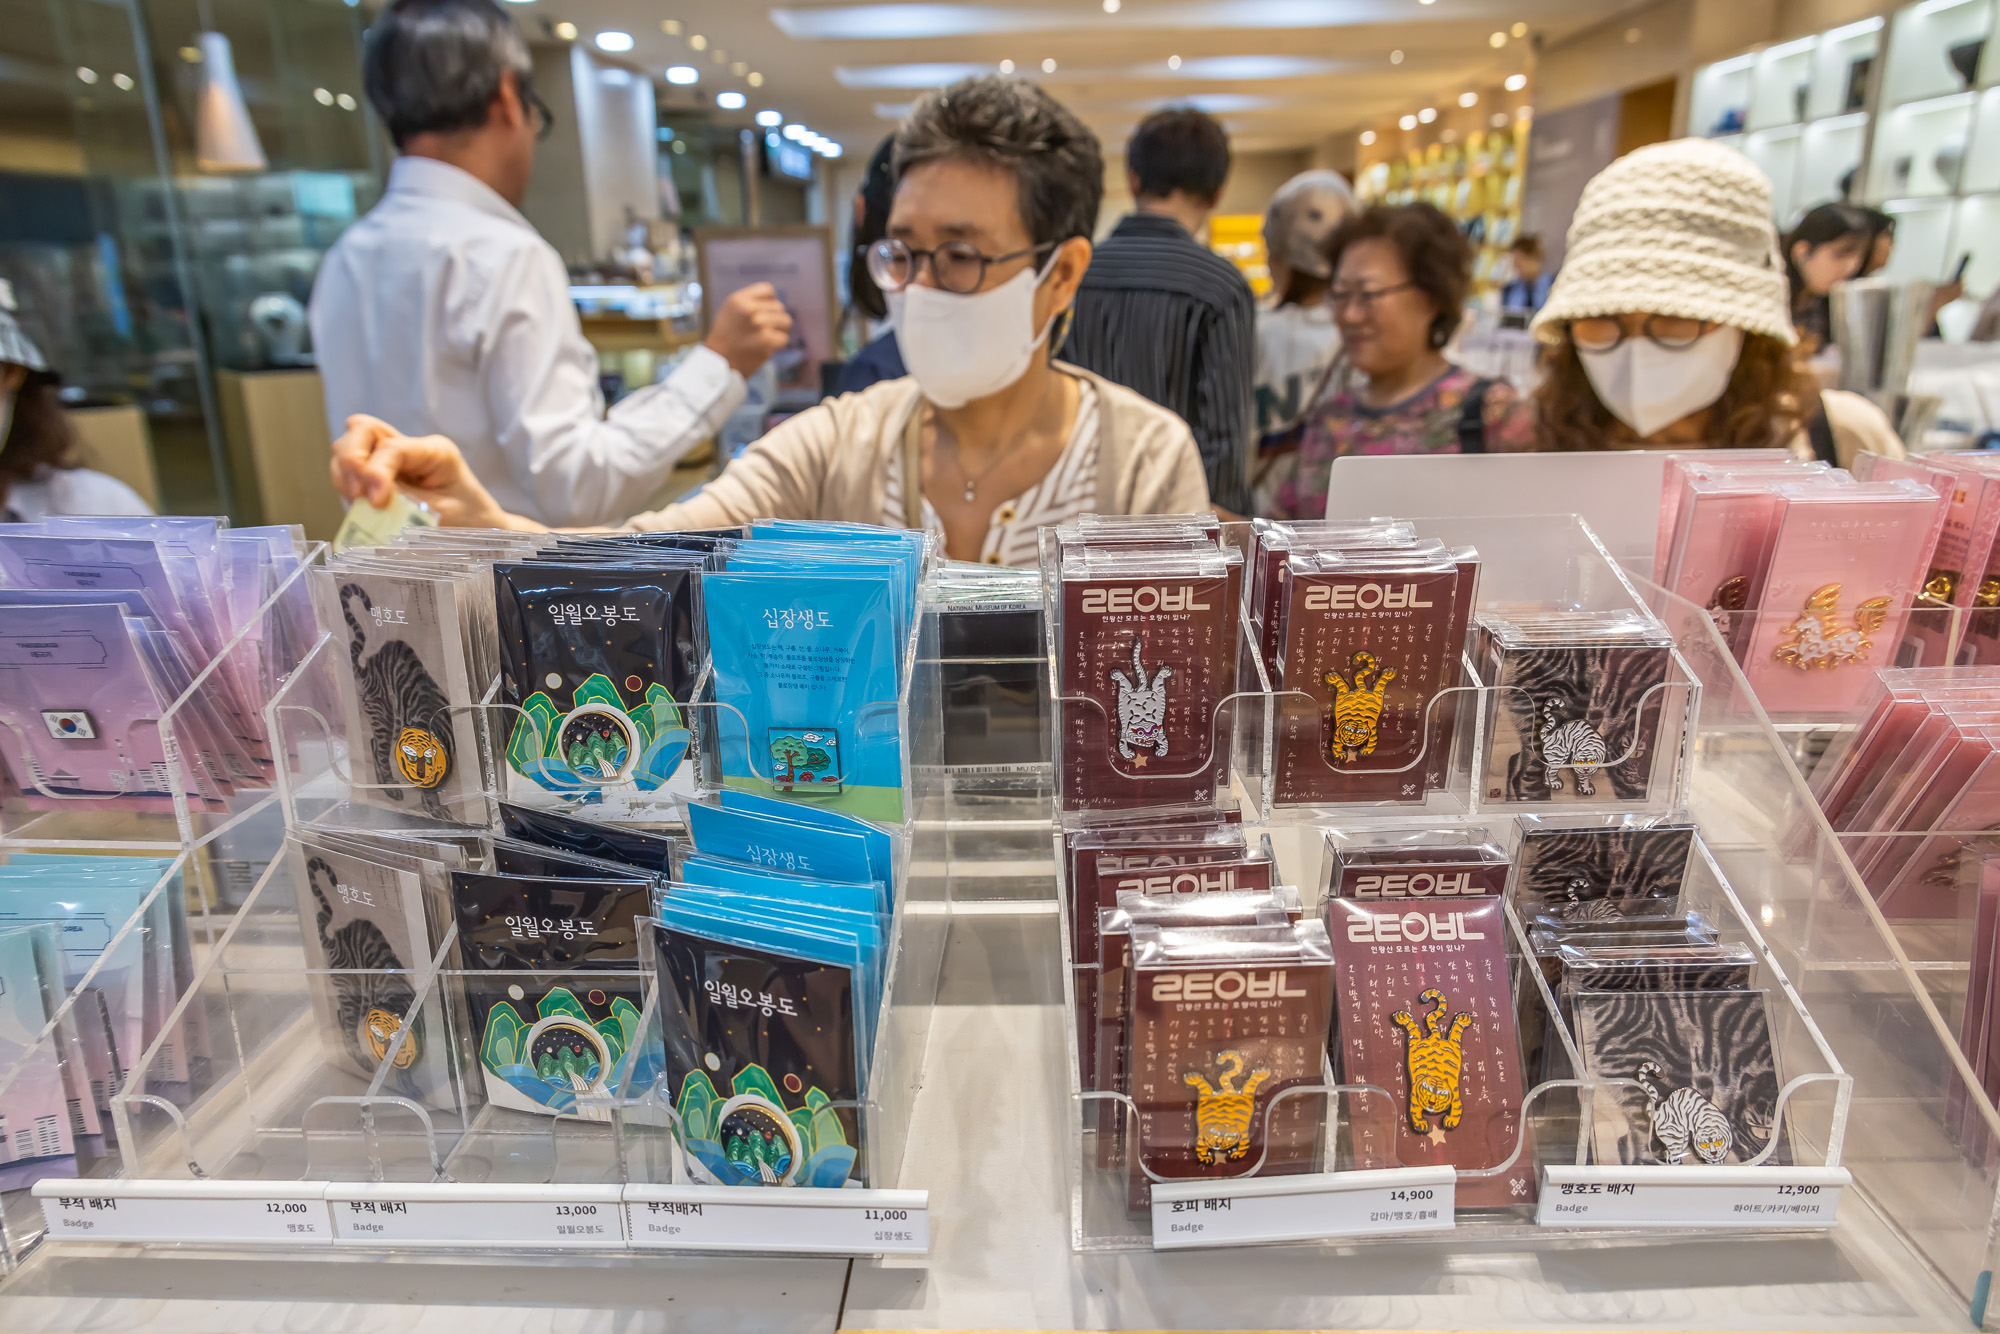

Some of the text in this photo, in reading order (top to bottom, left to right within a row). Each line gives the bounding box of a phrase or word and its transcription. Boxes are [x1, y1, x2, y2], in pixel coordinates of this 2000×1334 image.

[370, 606, 408, 627] 맹호도
[548, 604, 640, 626] 일월오봉도
[762, 608, 834, 630] 십장생도
[1323, 612, 1344, 620] 인왕산
[1394, 610, 1412, 618] 있나?
[746, 845, 814, 871] 십장생도
[336, 884, 376, 907] 맹호도
[505, 916, 598, 940] 일월오봉도
[1370, 944, 1466, 954] 인왕산 모르는 호랑이 있나?
[704, 980, 798, 1017] 일월오봉도
[1560, 1183, 1635, 1195] 맹호도 배지
[1777, 1185, 1820, 1196] 12,900
[1390, 1190, 1434, 1201] 14,900
[60, 1198, 117, 1210] 부적 배지
[266, 1203, 308, 1214] 12,000
[350, 1202, 407, 1215] 부적 배지
[647, 1202, 703, 1216] 부적배지
[1171, 1198, 1232, 1213] 호피 배지
[1555, 1204, 1588, 1213] Badge
[1733, 1204, 1820, 1214] 화이트/카키/베이지
[556, 1206, 597, 1217] 13,000
[865, 1210, 907, 1222] 11,000
[63, 1218, 94, 1229] Badge
[287, 1224, 316, 1233] 맹호도
[353, 1223, 384, 1232] Badge
[648, 1224, 681, 1234] Badge
[1171, 1222, 1204, 1233] Badge
[556, 1225, 604, 1235] 일월오봉도
[874, 1231, 913, 1241] 십장생도
